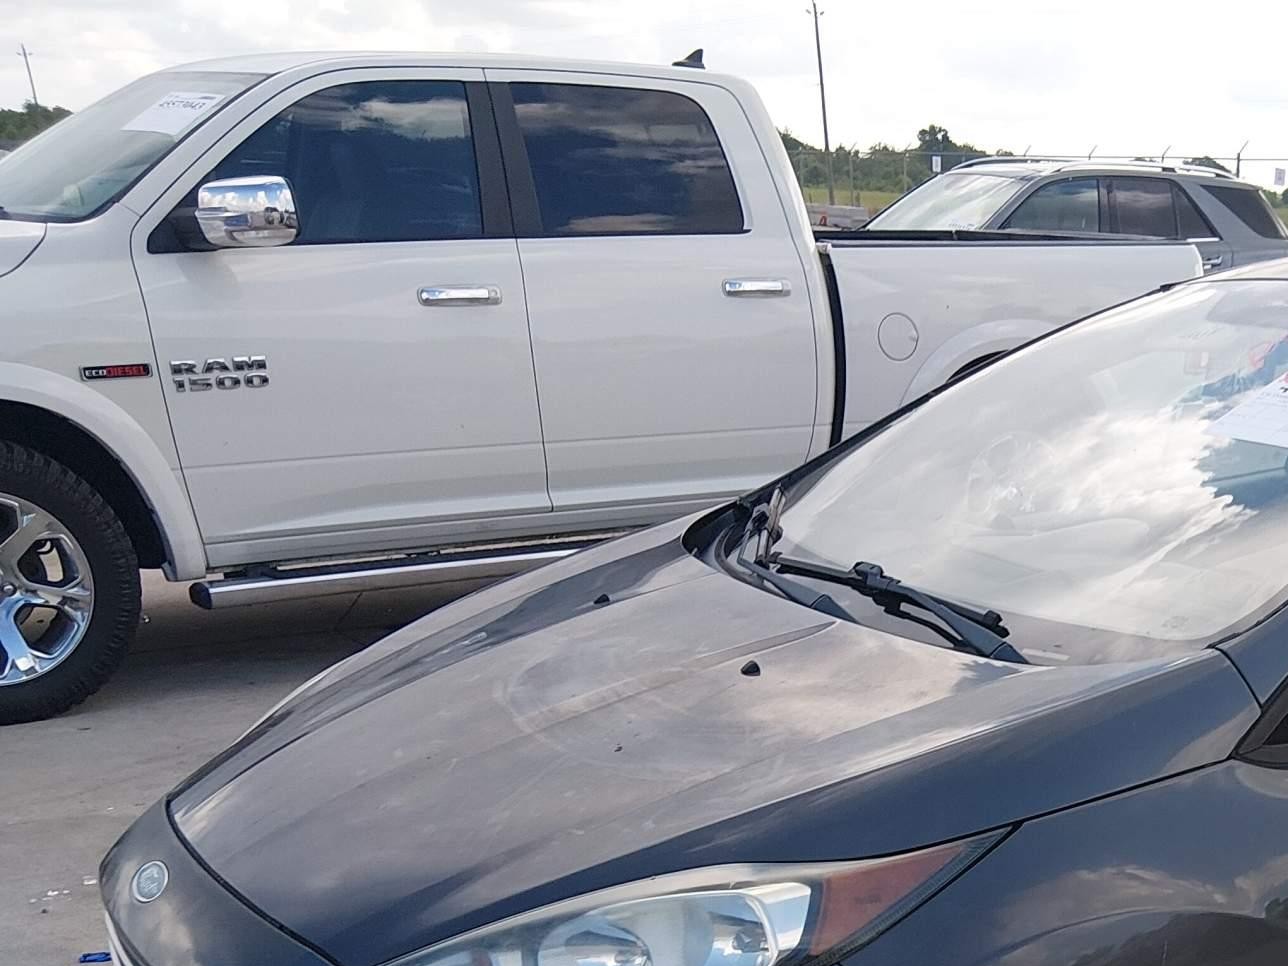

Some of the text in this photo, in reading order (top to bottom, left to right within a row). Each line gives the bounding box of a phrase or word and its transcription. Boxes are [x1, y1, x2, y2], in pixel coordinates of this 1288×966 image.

[84, 364, 147, 378] ECODIESEL
[169, 355, 267, 376] RAM
[172, 372, 270, 393] 1500
